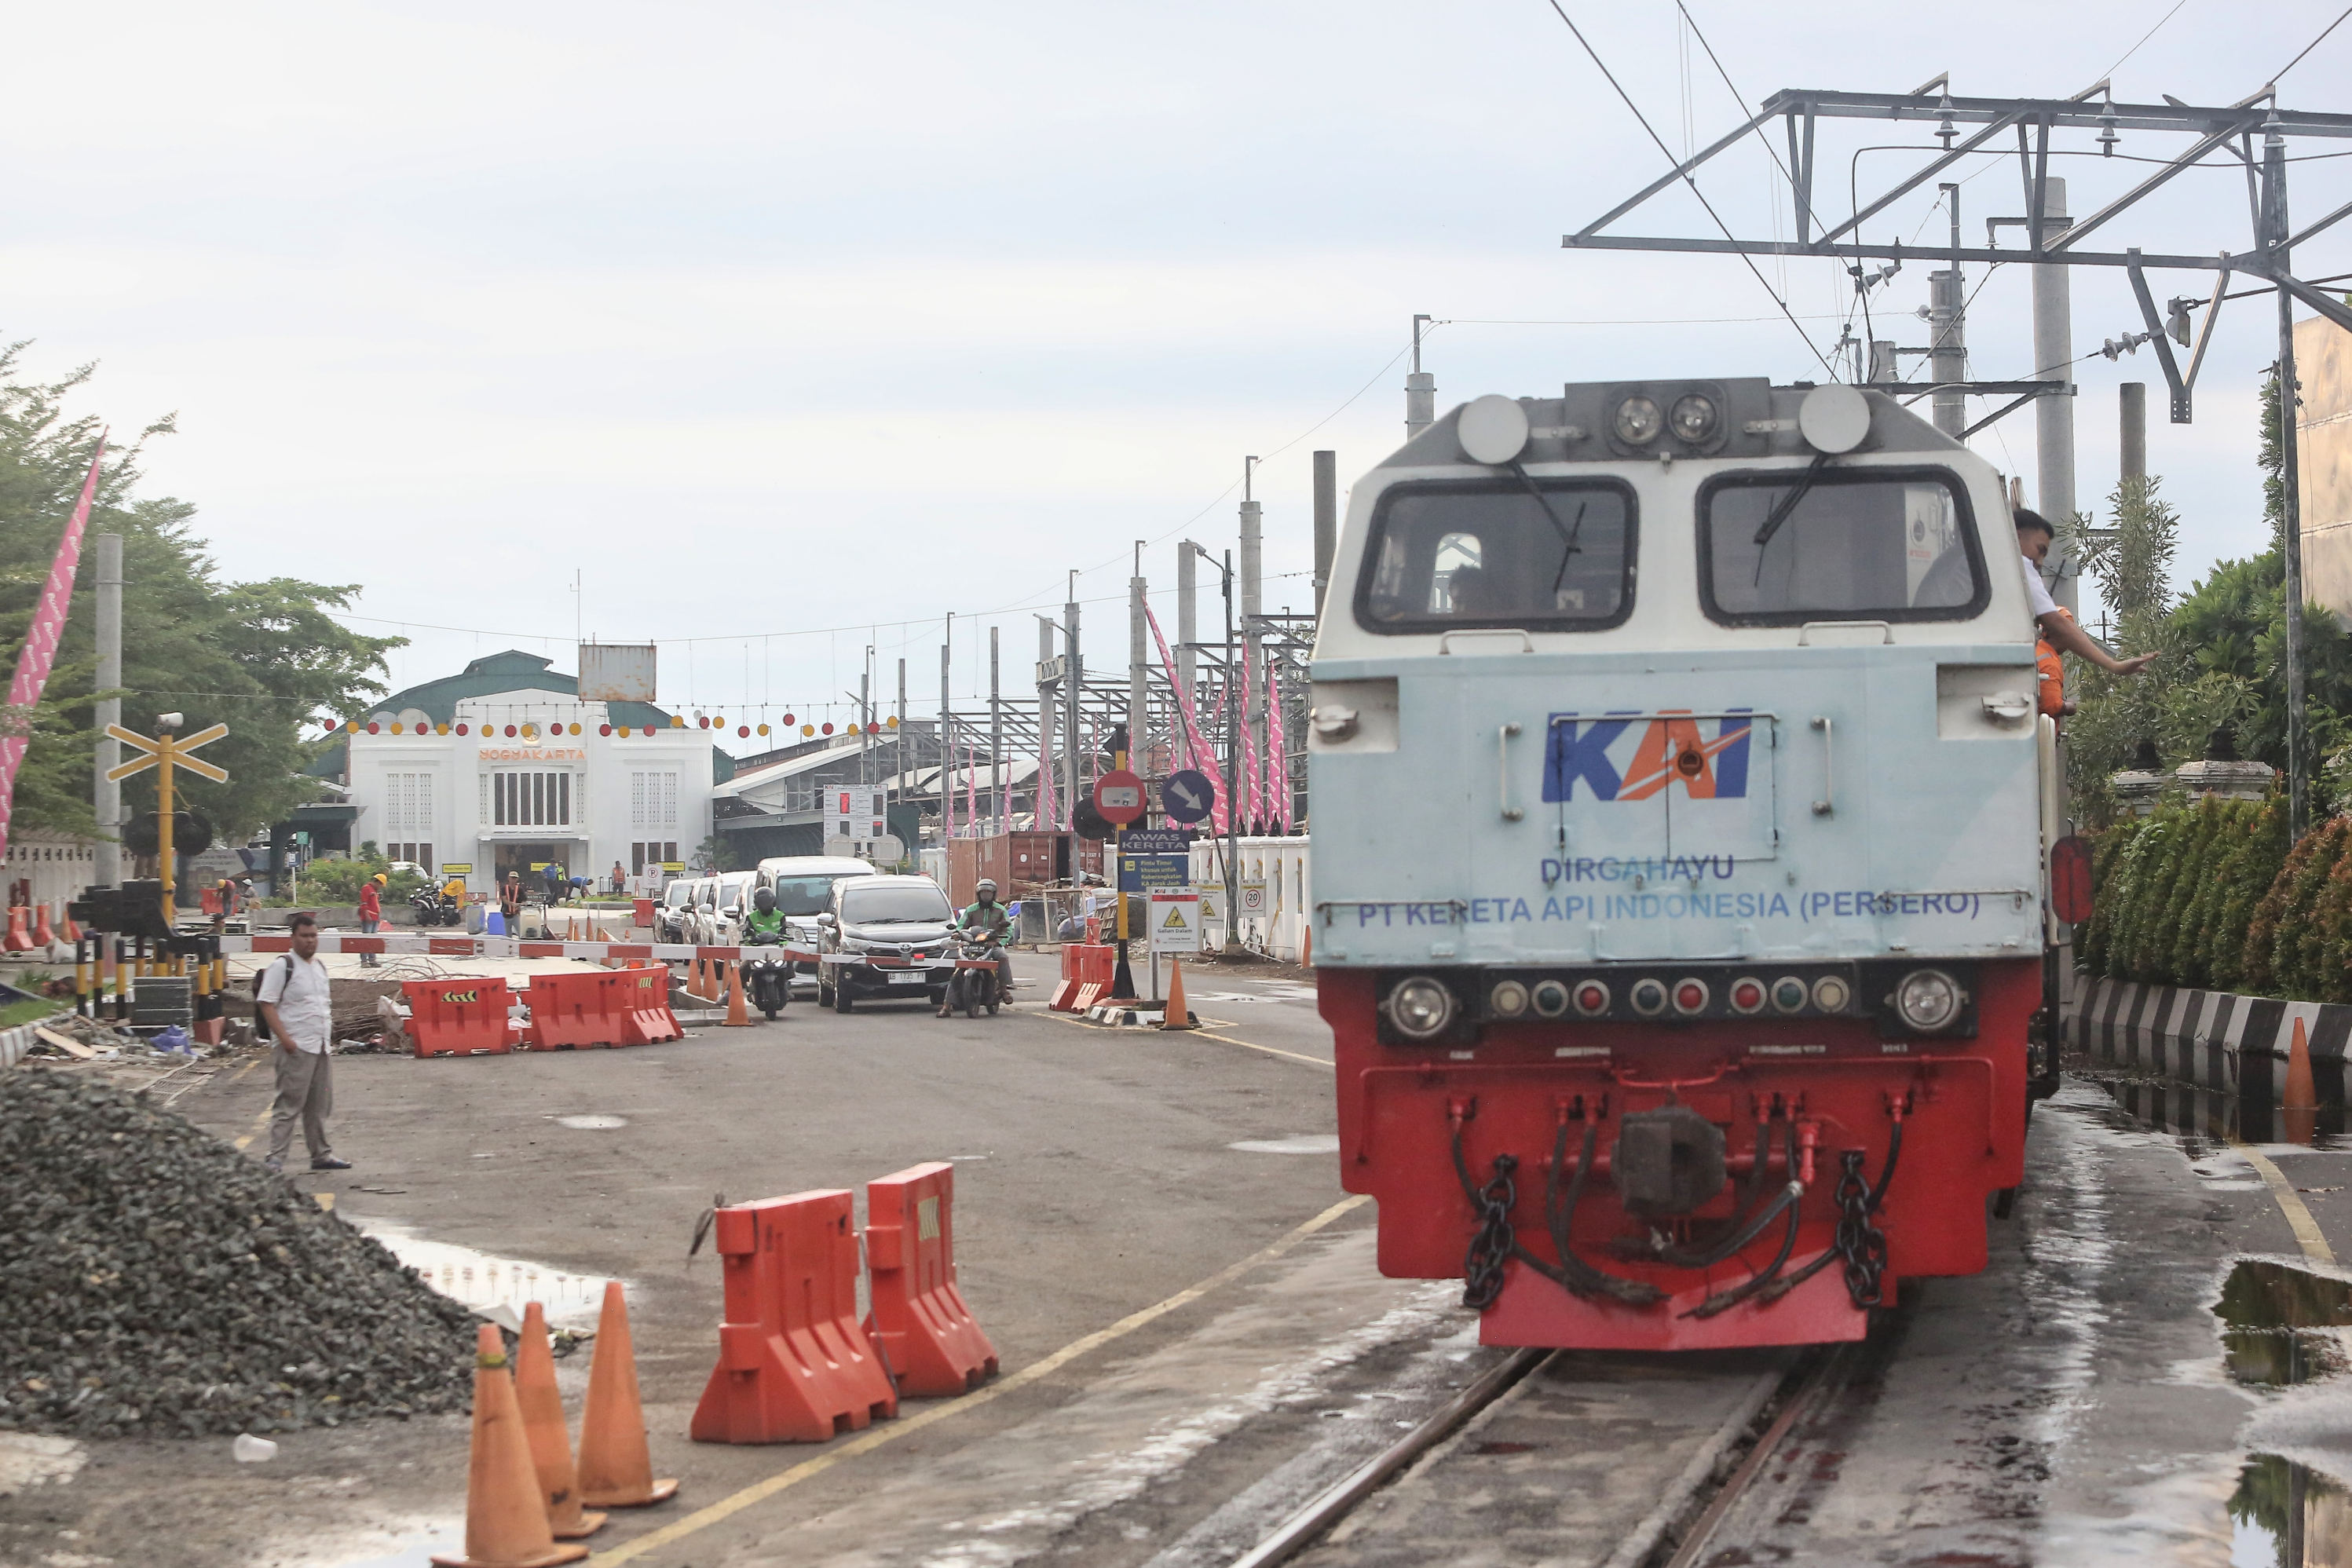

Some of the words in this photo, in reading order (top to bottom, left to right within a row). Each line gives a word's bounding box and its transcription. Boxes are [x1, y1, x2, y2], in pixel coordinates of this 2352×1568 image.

[479, 749, 586, 760] YOGYAKARTA
[1542, 708, 1753, 802] KAI
[1541, 854, 1734, 884] DIRGAHAYU
[1359, 903, 1396, 928] PT
[1406, 897, 1532, 926] KERETA
[1542, 894, 1594, 922] API
[1606, 891, 1790, 920] INDONESIA
[1799, 890, 1981, 923] (PERSERO)
